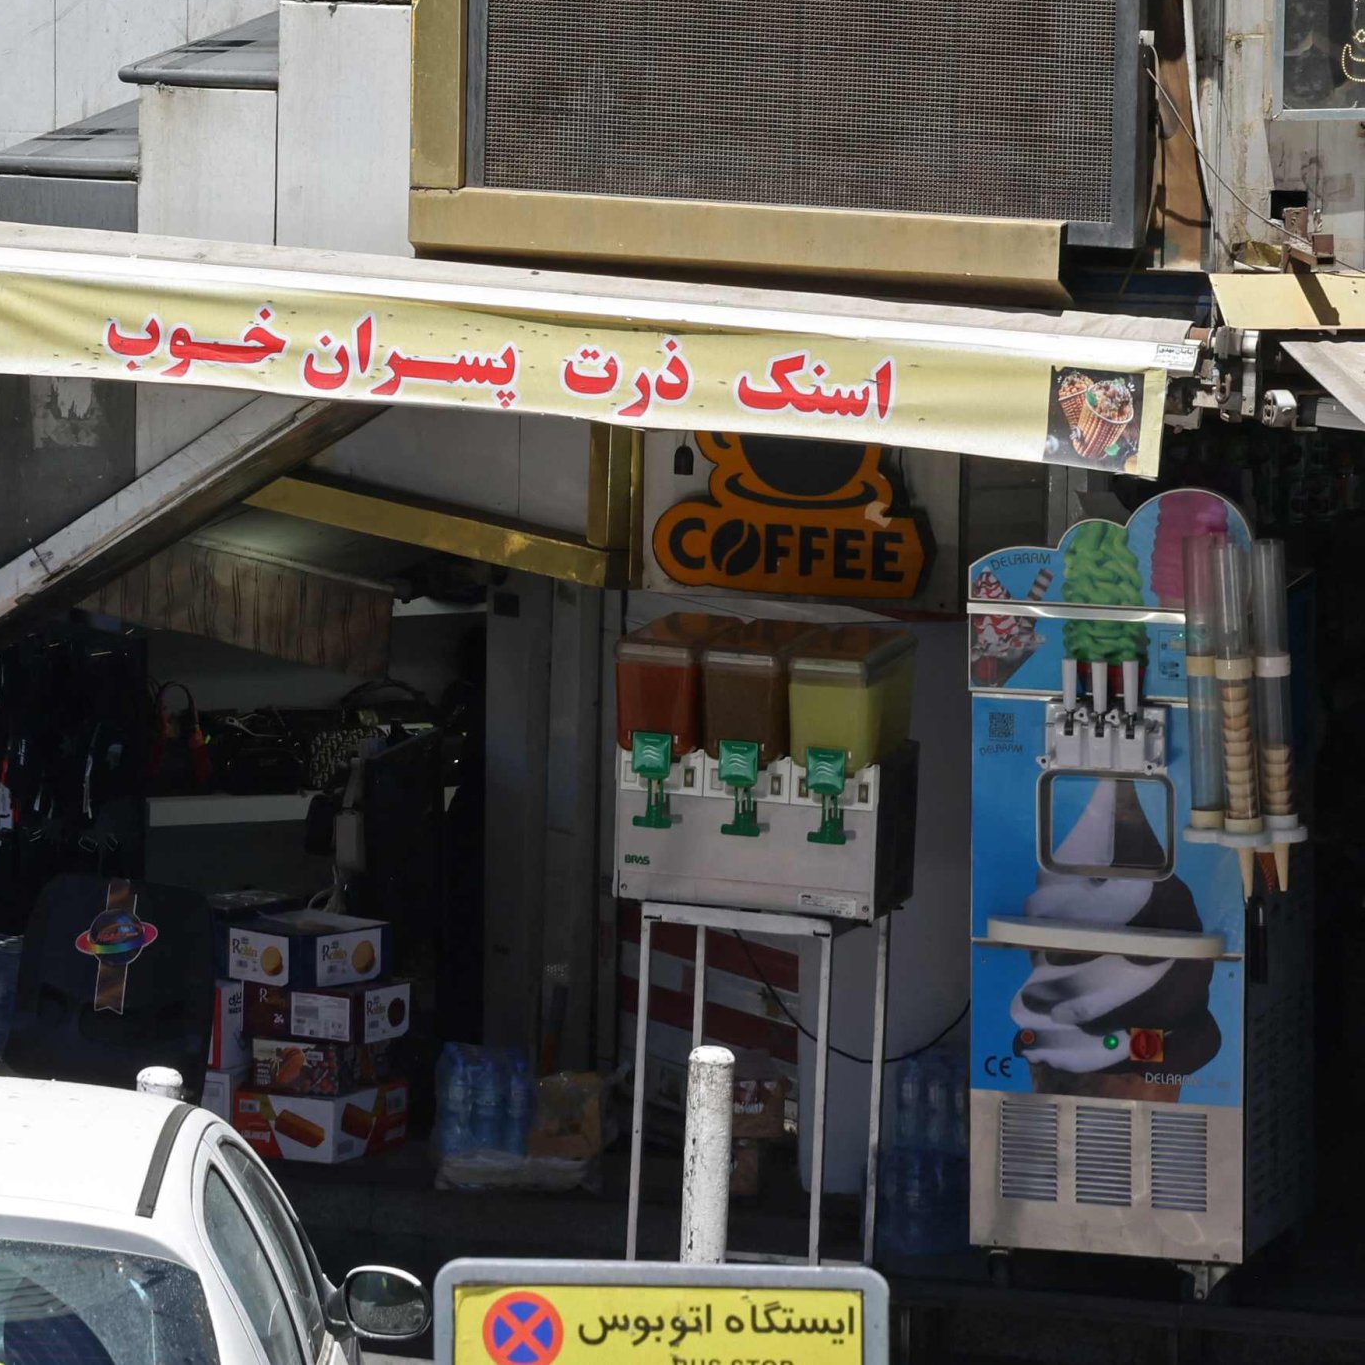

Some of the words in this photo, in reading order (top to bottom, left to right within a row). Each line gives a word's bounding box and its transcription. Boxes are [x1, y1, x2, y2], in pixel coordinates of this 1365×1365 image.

[106, 304, 287, 377] خوب
[304, 313, 518, 407] پسران
[566, 340, 692, 416] ذرت
[737, 356, 894, 420] اسنک
[668, 516, 907, 584] COFFEE
[989, 552, 1052, 571] DELARAM
[624, 854, 651, 866] BRAS
[984, 1055, 1012, 1078] CE
[577, 1303, 712, 1346] اتوبوس
[724, 1300, 855, 1346] ایستگاه
